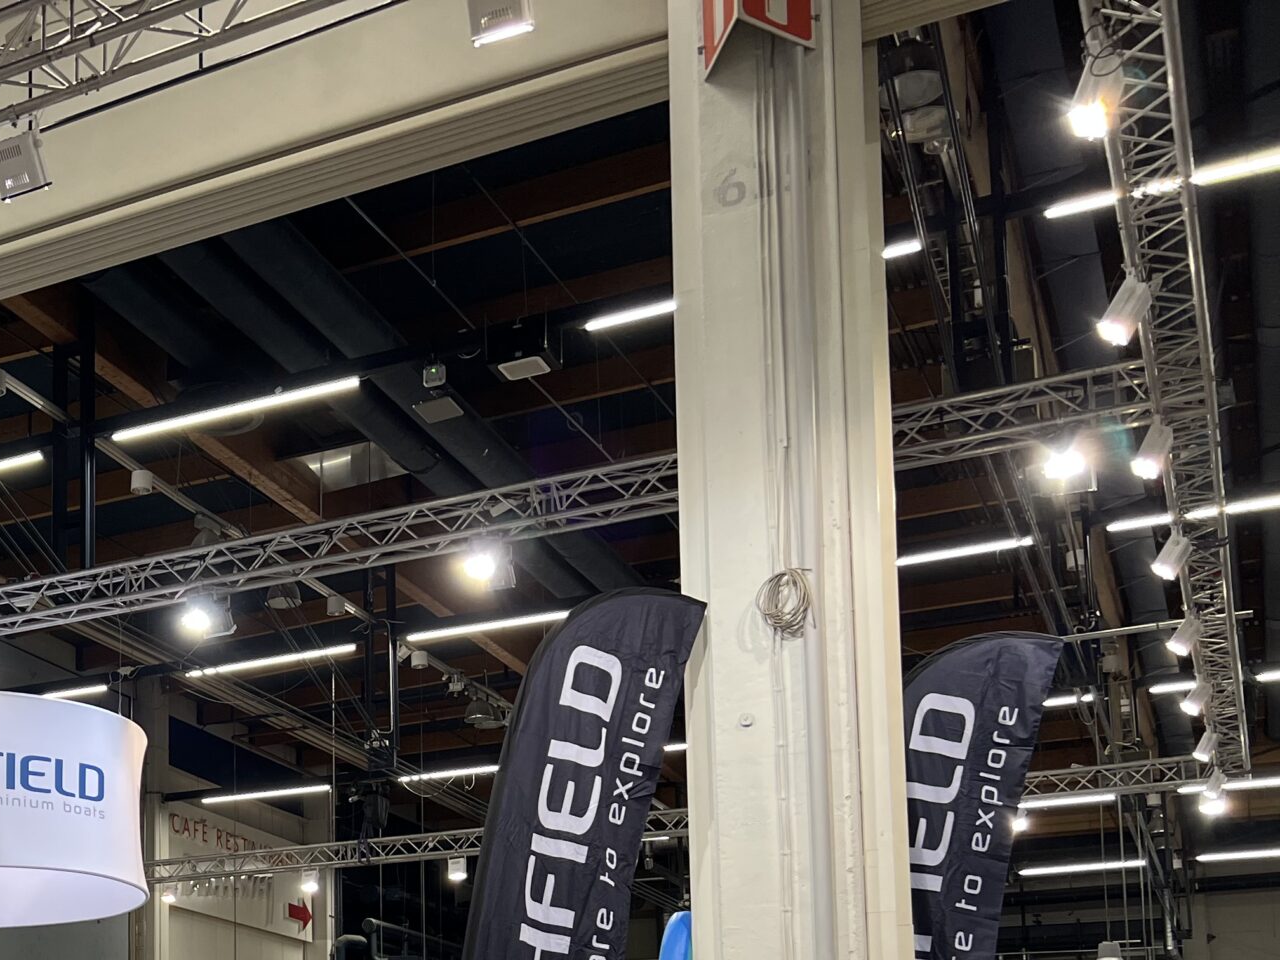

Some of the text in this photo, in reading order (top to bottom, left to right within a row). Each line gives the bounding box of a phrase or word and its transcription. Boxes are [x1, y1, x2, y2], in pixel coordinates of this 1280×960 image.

[63, 802, 106, 819] boats
[600, 849, 617, 887] to
[609, 667, 665, 824] explore
[956, 874, 983, 911] to
[972, 705, 1019, 852] explore
